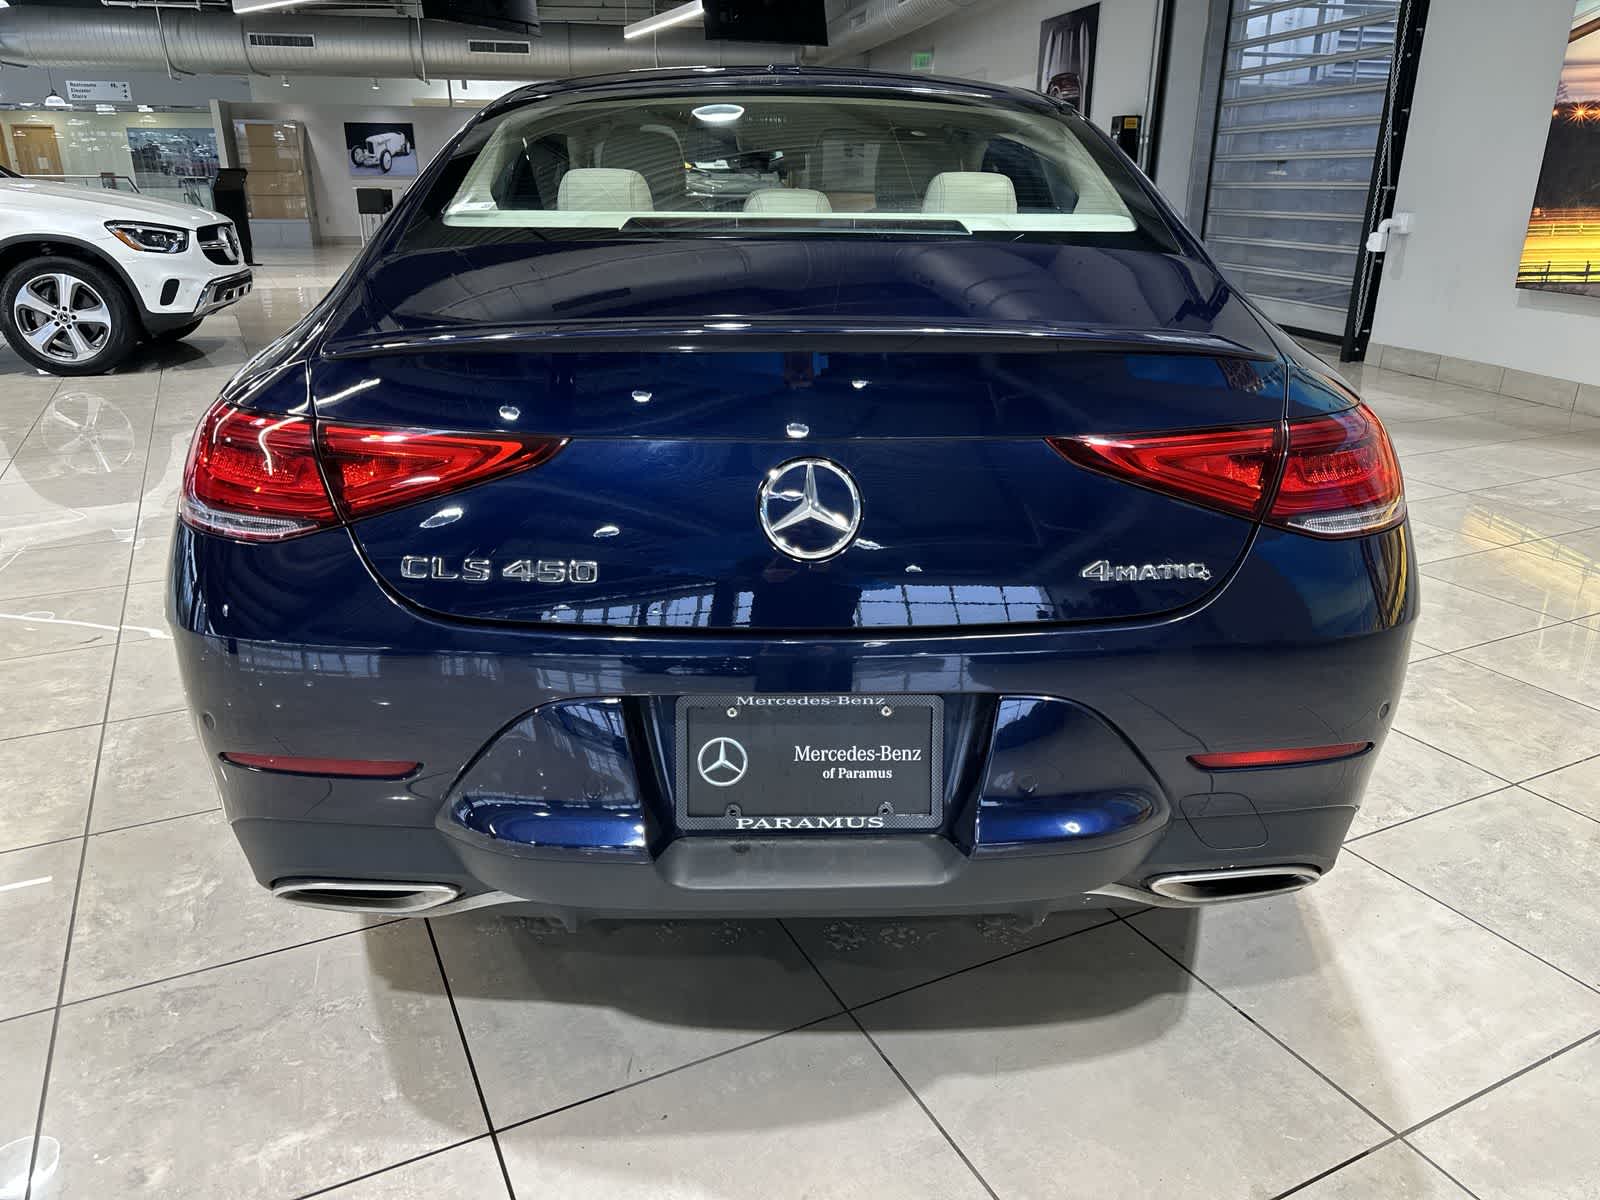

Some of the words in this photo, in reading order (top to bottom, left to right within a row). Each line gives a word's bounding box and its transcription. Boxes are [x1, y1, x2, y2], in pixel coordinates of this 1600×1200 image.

[400, 555, 491, 581] CLS
[502, 559, 598, 583] 450
[736, 696, 886, 706] Mercedes-Benz
[794, 745, 922, 762] Mercedes-Benz
[822, 768, 834, 779] of
[838, 768, 893, 779] Paramus
[736, 817, 884, 830] PARAMUS
